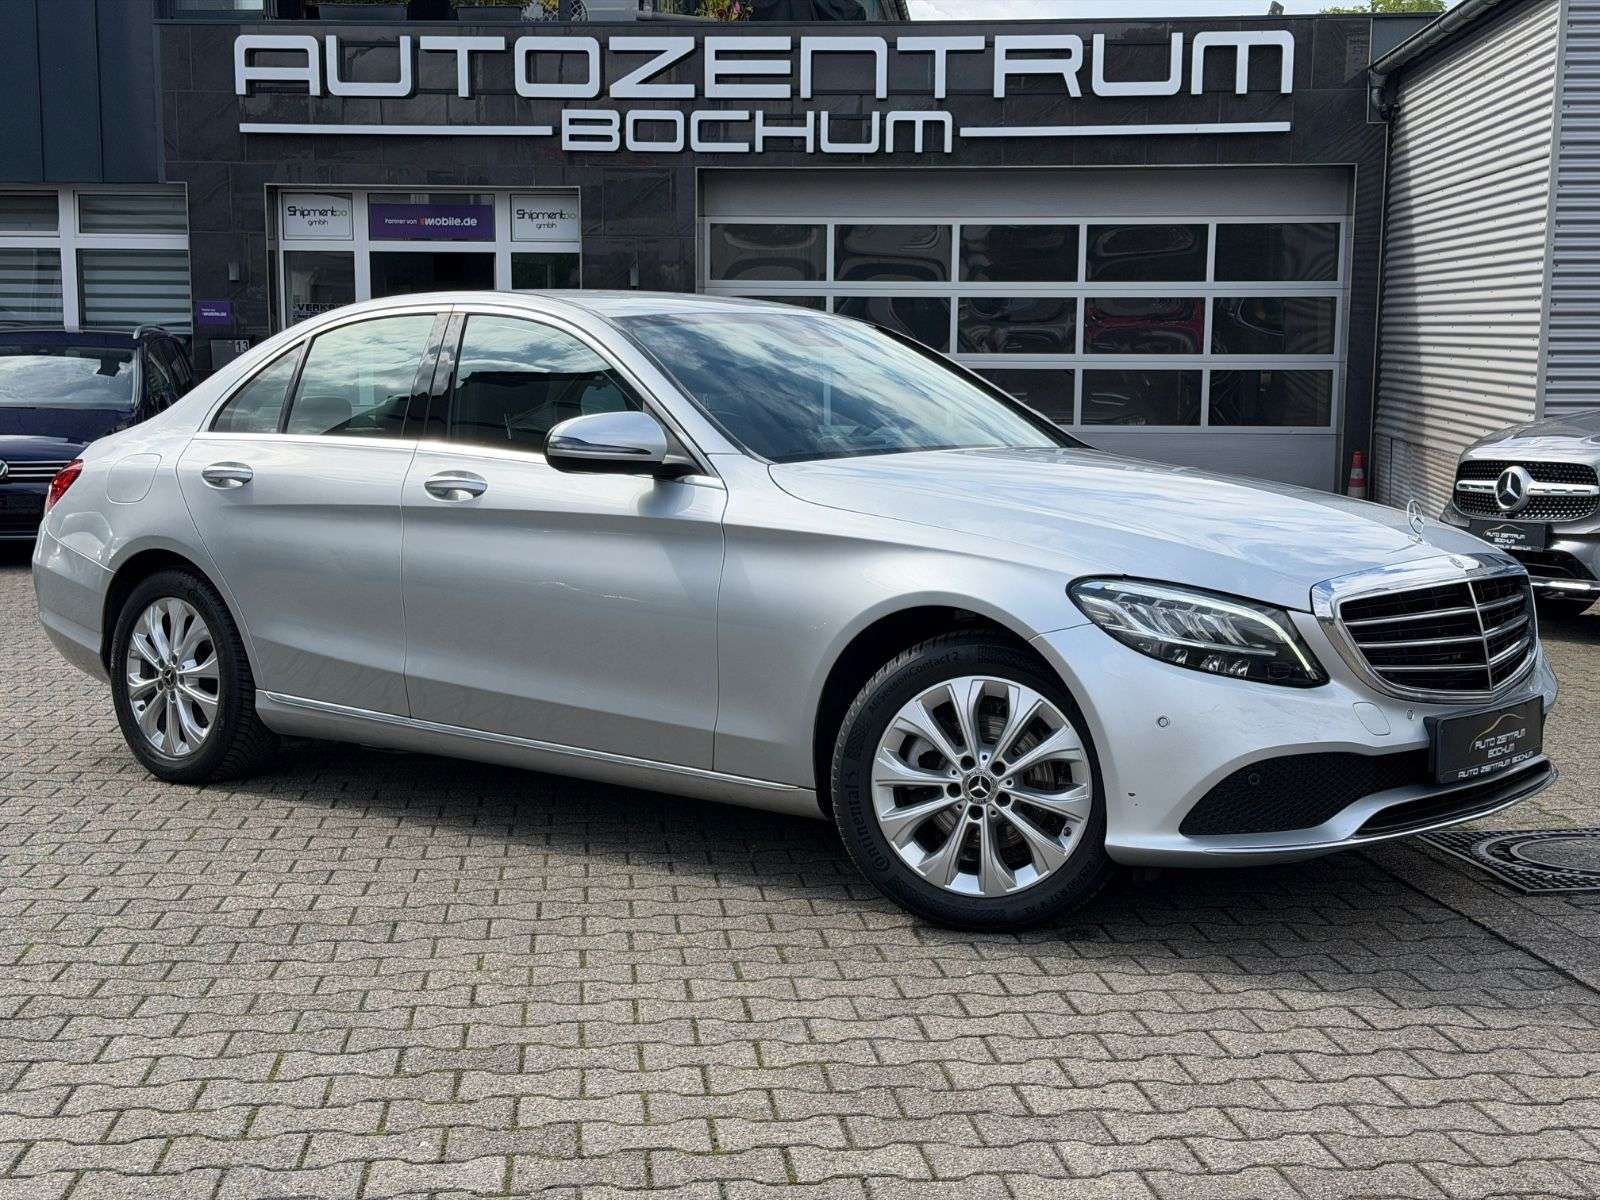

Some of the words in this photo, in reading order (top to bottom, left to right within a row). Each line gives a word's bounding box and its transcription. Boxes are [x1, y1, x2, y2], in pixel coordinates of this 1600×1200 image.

[234, 30, 1295, 100] AUTOZENTRUM
[561, 109, 953, 154] BOCHUM
[424, 216, 478, 226] mobile.de
[1475, 737, 1496, 751] AUTO
[1497, 728, 1527, 745] ZENTRUM
[1487, 742, 1516, 758] BOCHUM
[1457, 767, 1479, 779] AUTO
[1480, 758, 1512, 774] ZENTRUM
[1511, 750, 1535, 764] BOCHUM
